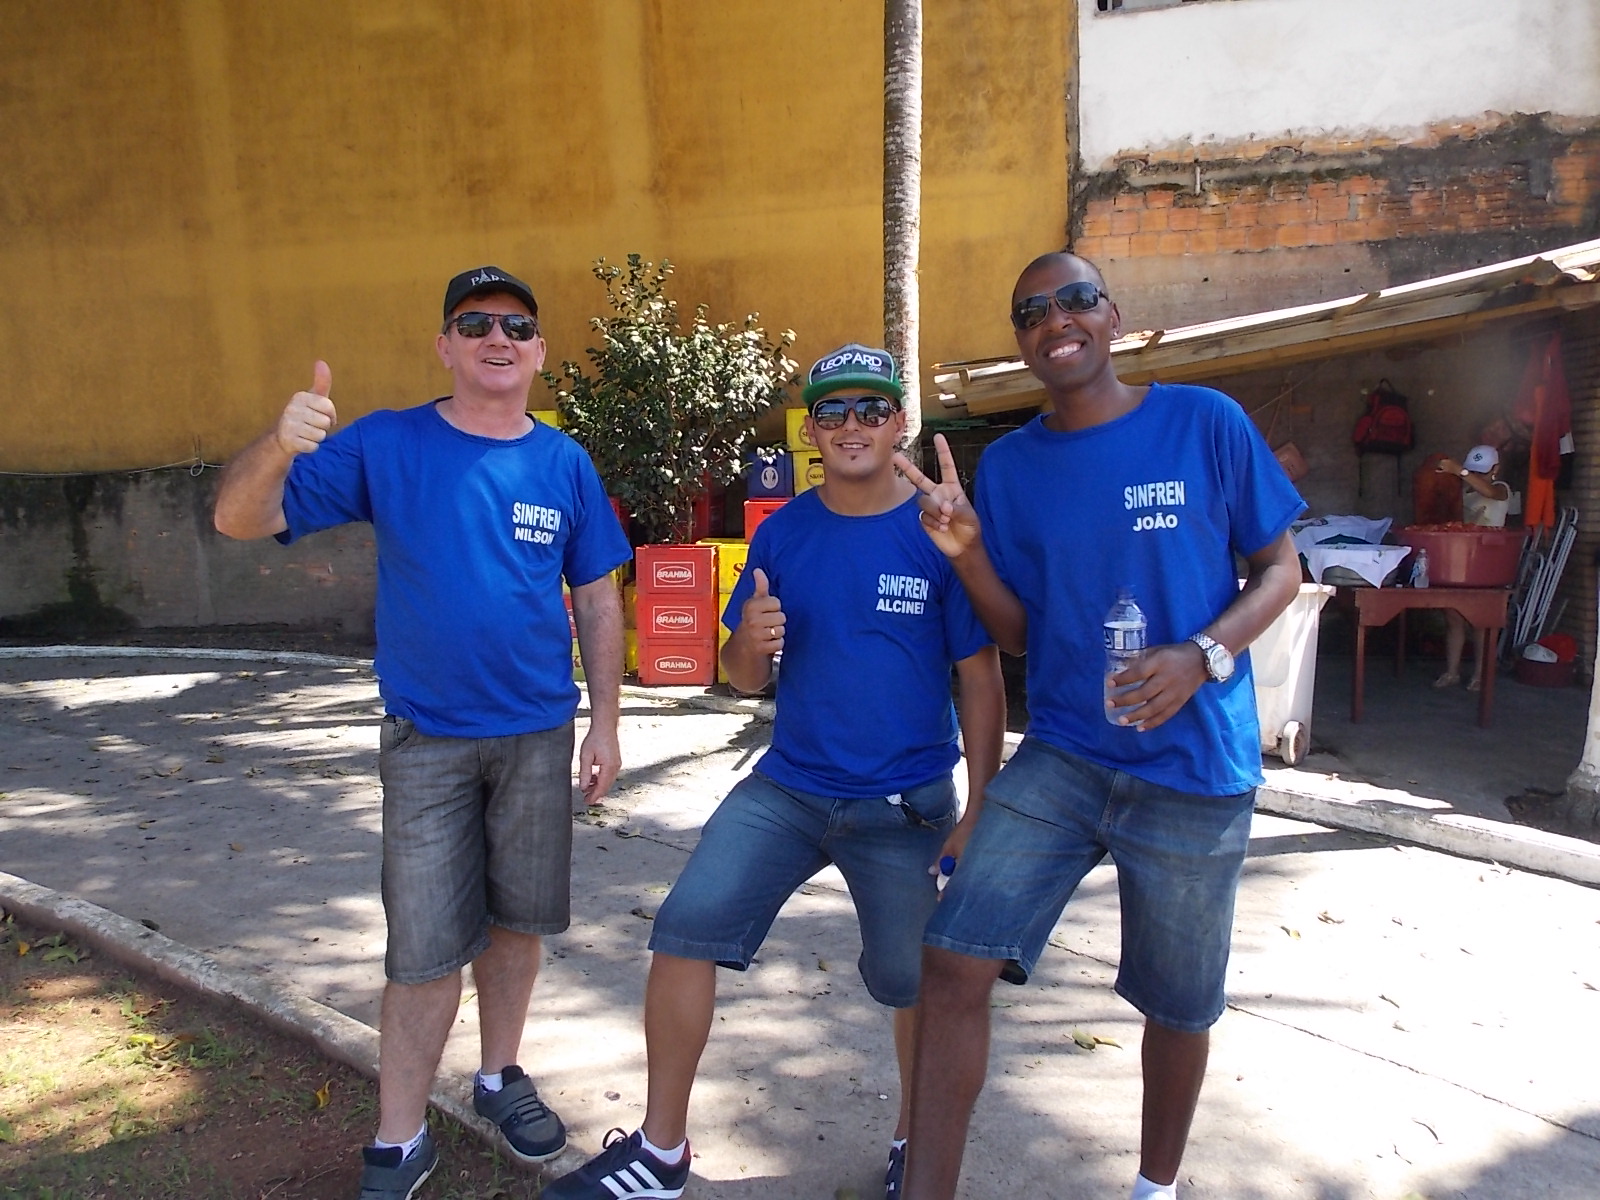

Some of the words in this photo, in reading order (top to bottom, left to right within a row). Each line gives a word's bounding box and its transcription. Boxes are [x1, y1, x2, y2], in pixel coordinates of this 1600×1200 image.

[820, 353, 882, 372] LEOPARD
[1124, 481, 1185, 510] SINFREN
[512, 501, 562, 532] SINFREN
[1132, 512, 1178, 532] JOÃO
[514, 527, 555, 545] NILSON
[877, 573, 929, 601] SINFREN
[875, 598, 924, 615] ALCINEI
[656, 615, 694, 624] BRAHMA
[659, 661, 692, 669] BRAHMA
